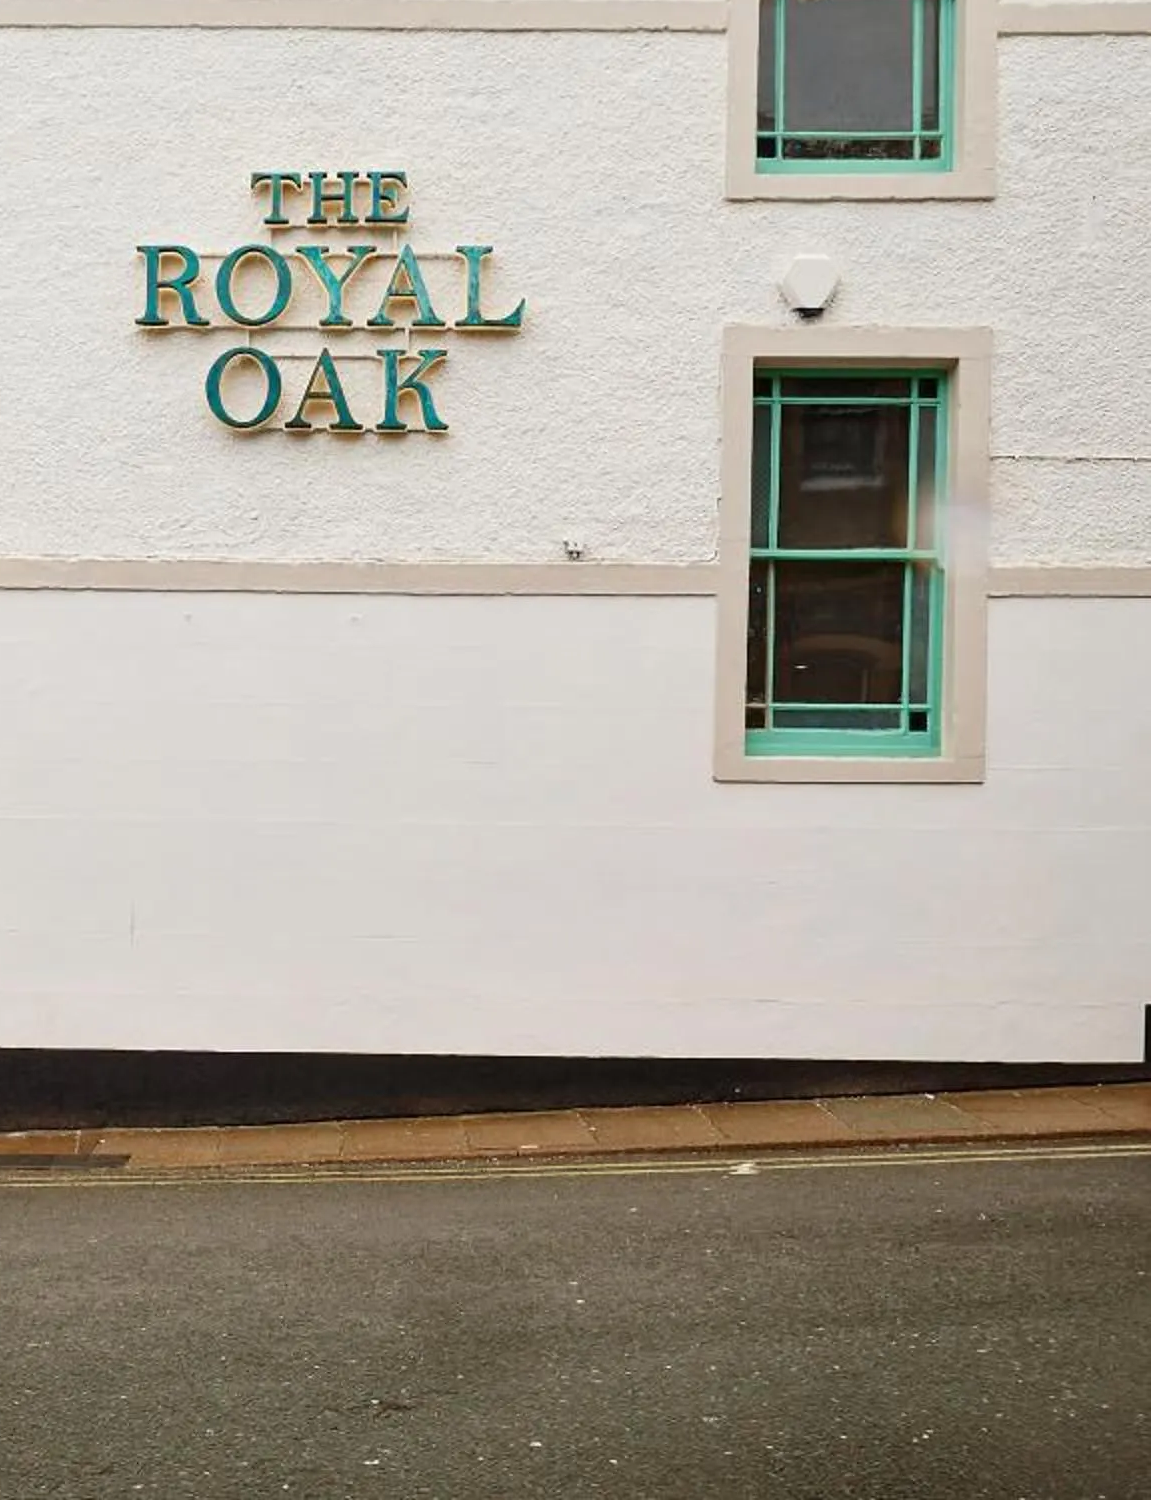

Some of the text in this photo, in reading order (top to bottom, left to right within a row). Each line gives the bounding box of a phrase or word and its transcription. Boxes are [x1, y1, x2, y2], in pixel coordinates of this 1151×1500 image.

[251, 171, 410, 225] THE
[135, 243, 526, 327] ROYAL
[205, 346, 450, 431] OAK
